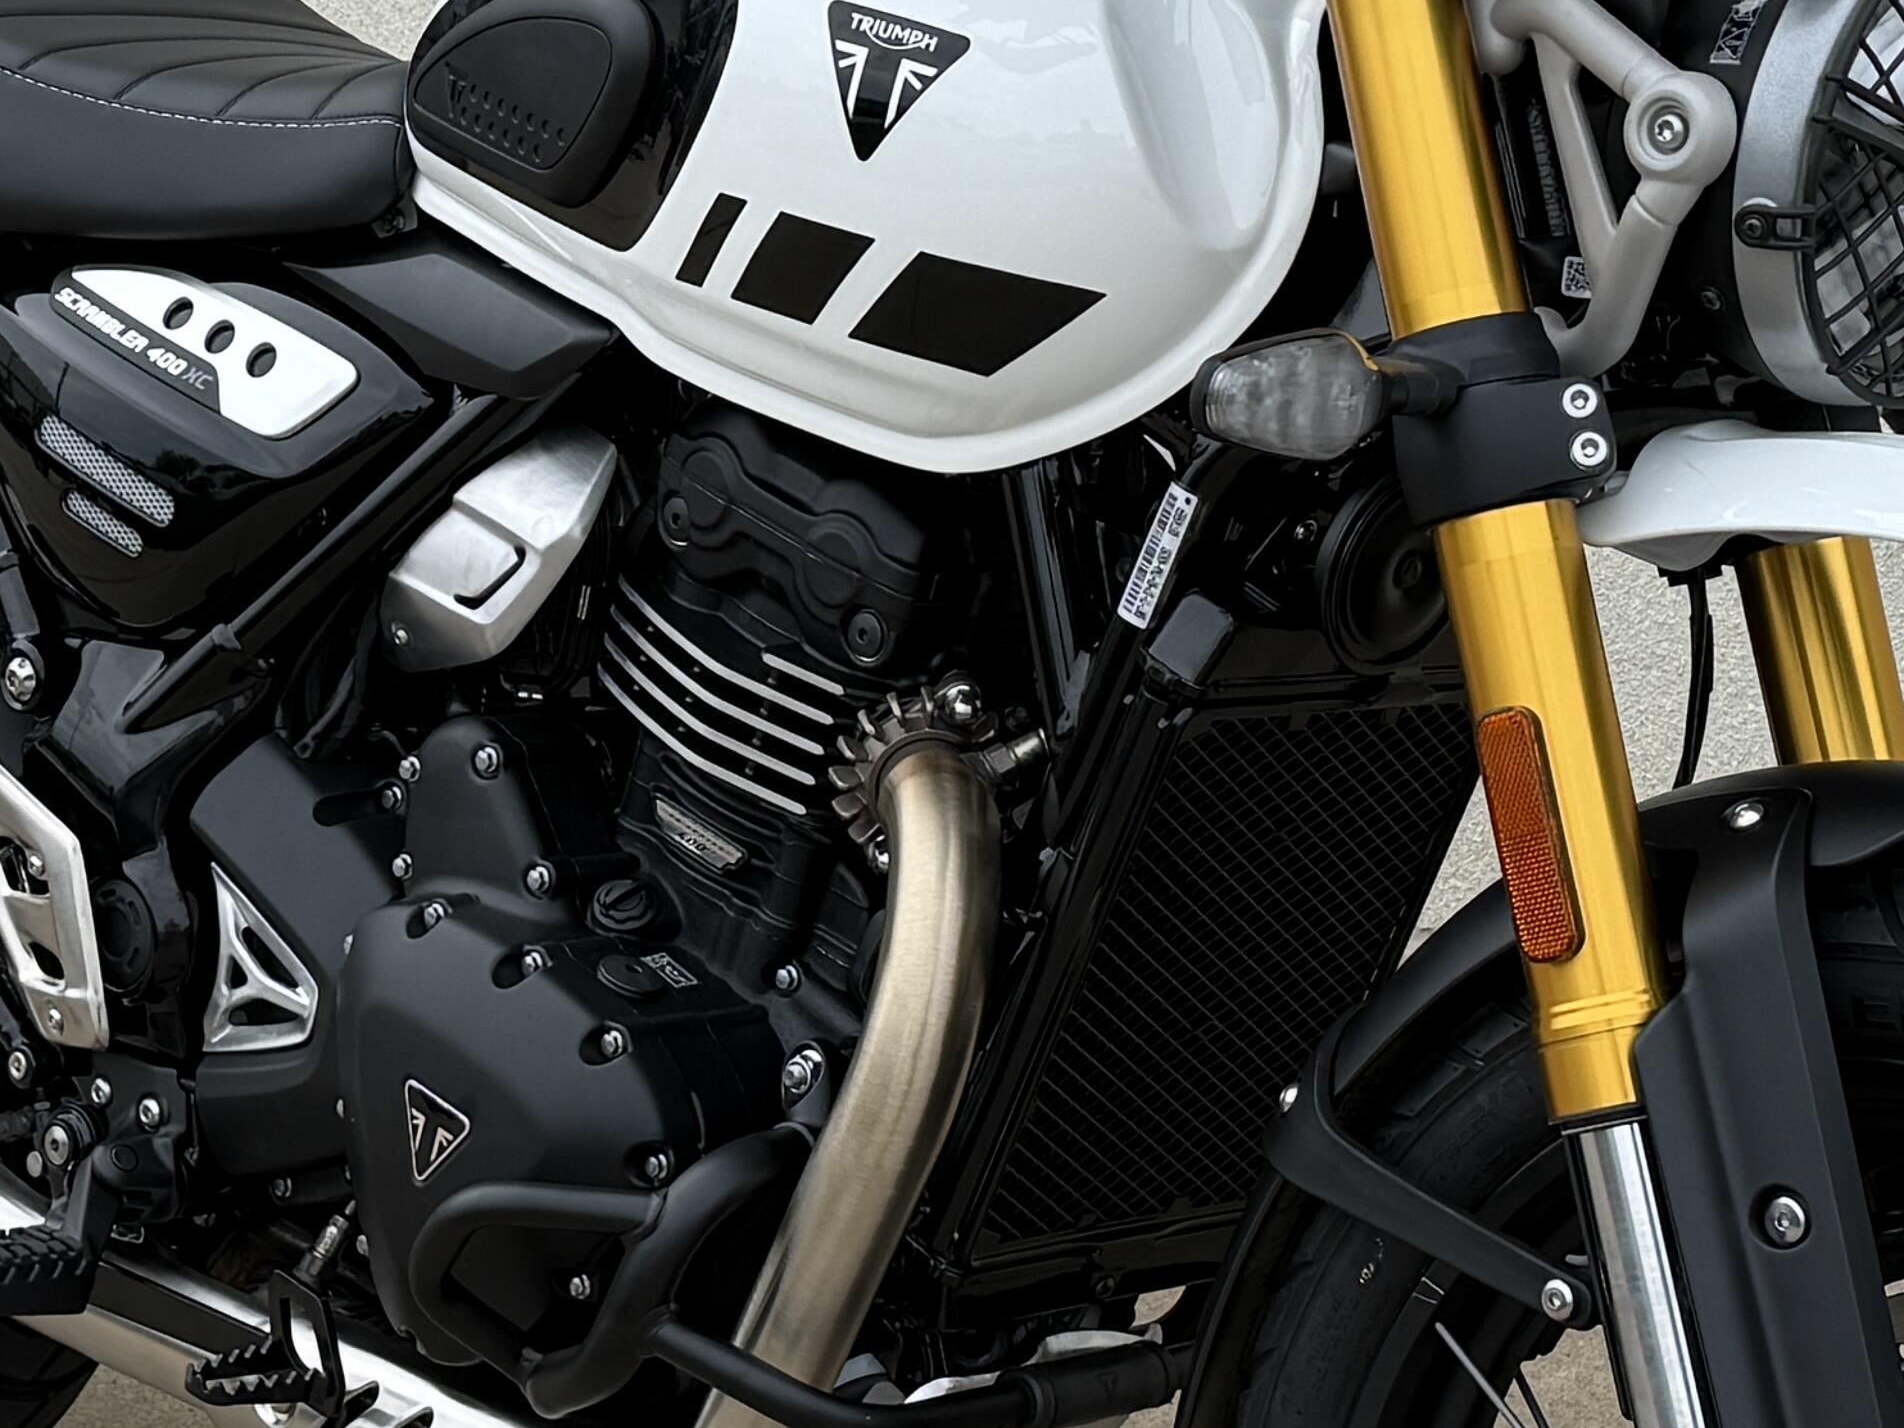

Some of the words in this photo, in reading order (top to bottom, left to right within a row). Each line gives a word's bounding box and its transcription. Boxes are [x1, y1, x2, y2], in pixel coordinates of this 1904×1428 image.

[851, 12, 938, 52] TRIUMPH
[54, 287, 149, 353] SCRAMBLER
[147, 348, 188, 376] 400
[181, 367, 214, 391] XC
